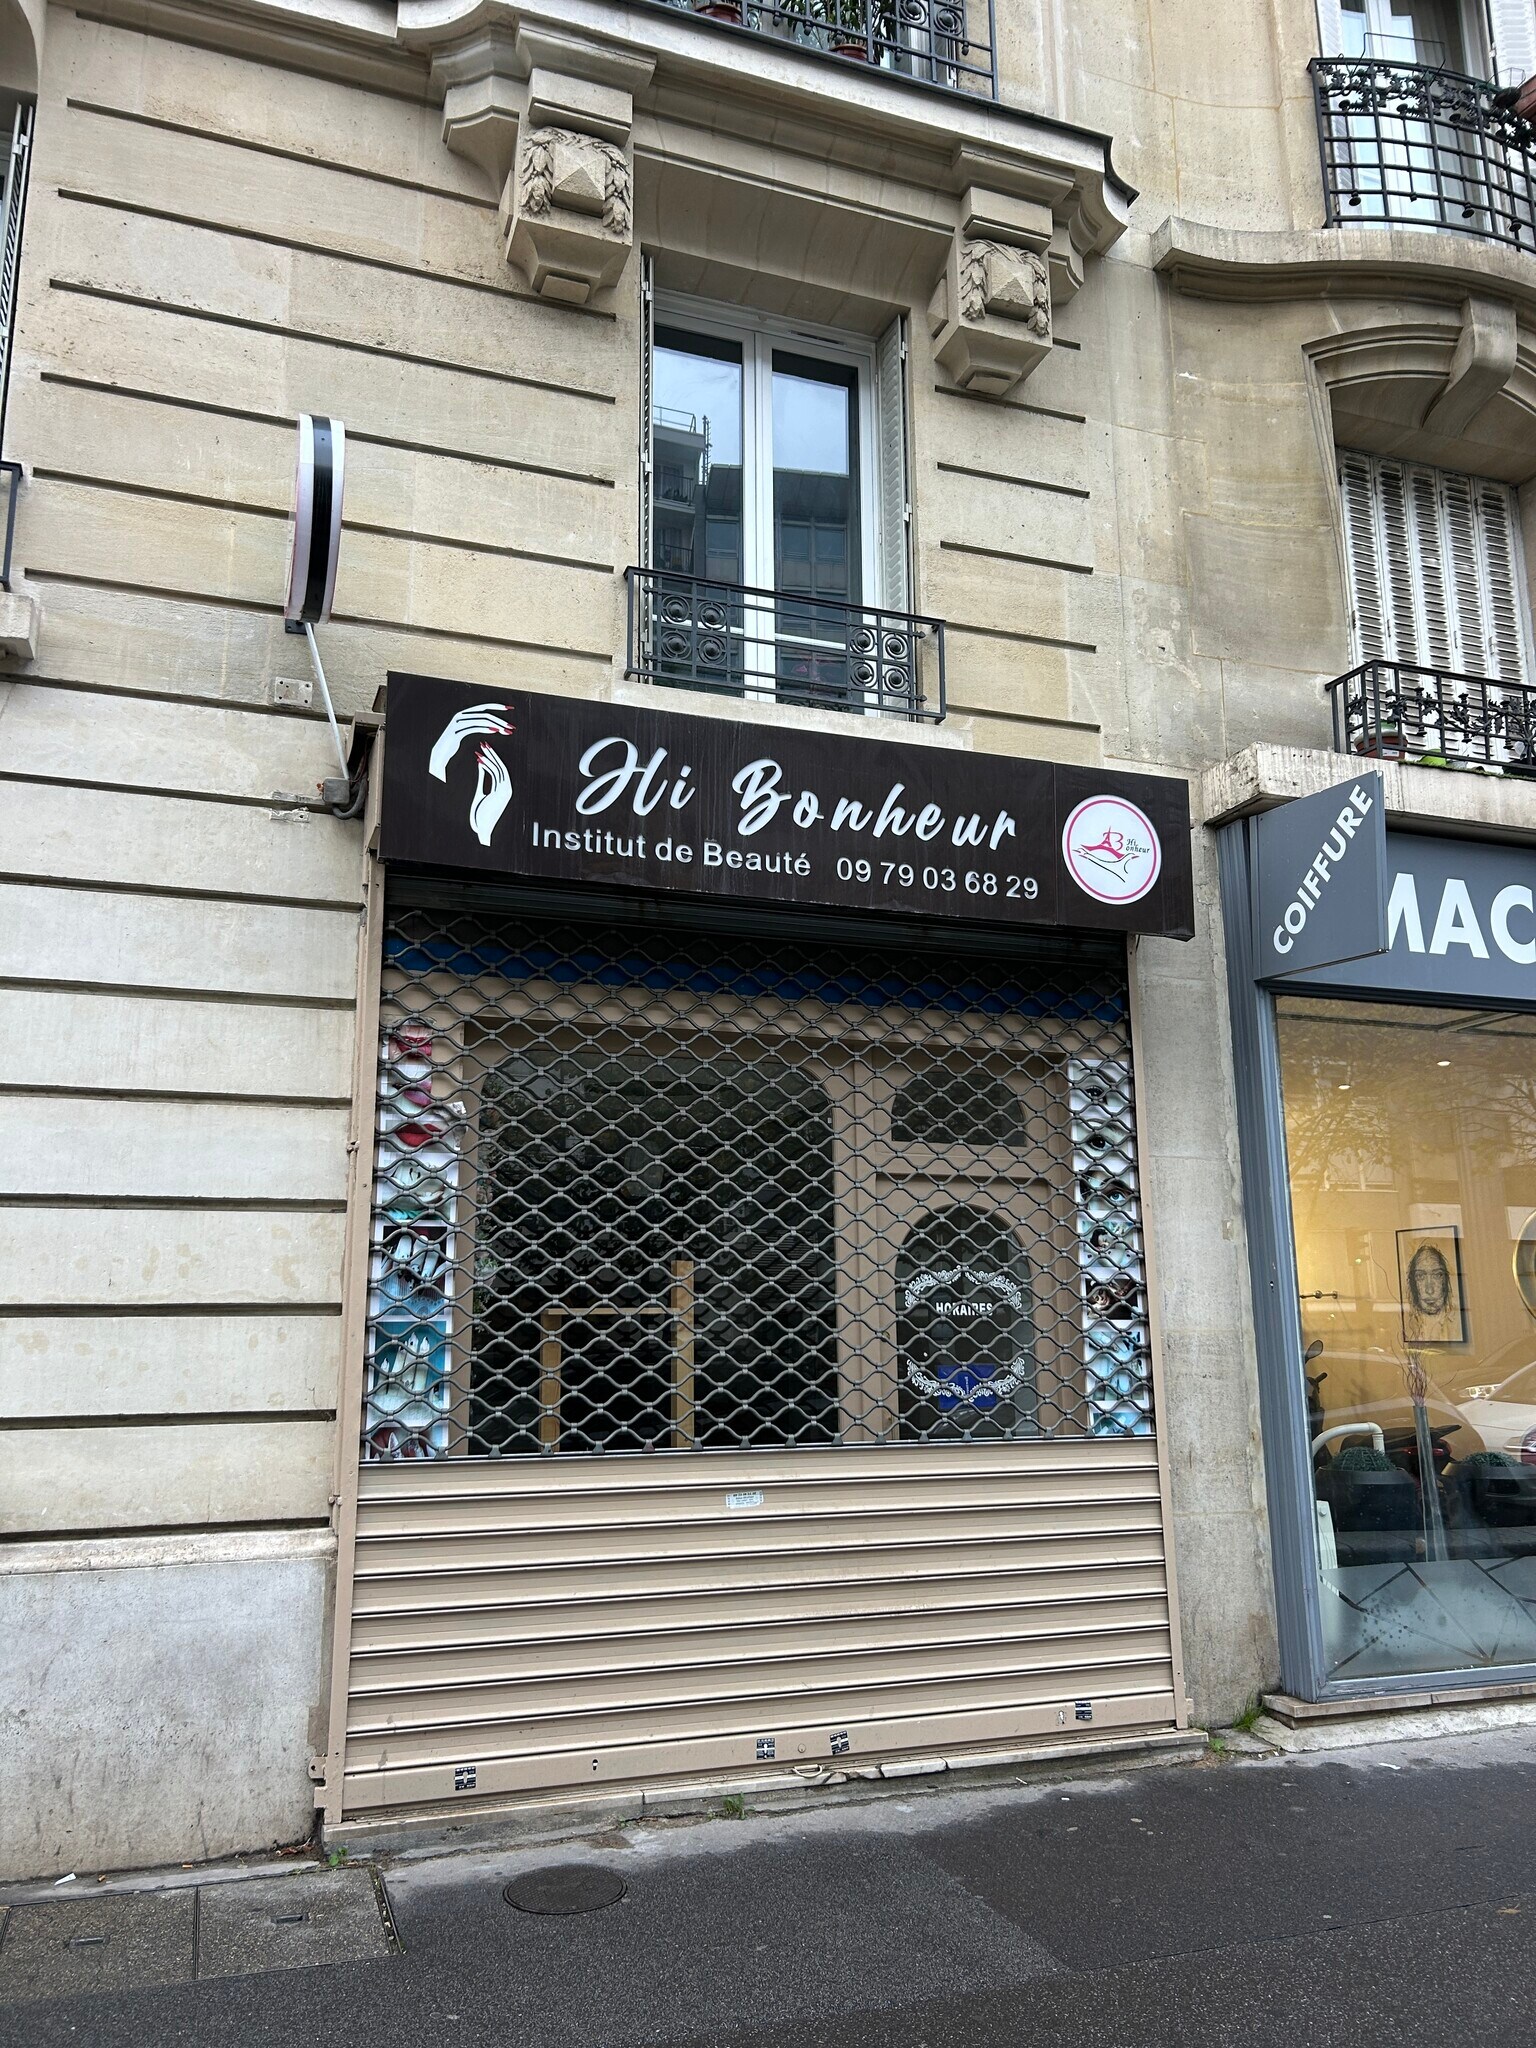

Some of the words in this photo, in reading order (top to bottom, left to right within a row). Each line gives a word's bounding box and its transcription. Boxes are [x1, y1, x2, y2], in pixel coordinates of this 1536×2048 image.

[575, 736, 696, 817] Hi
[731, 758, 1017, 851] Bonheur
[532, 821, 646, 859] Institut
[654, 837, 693, 863] de
[703, 841, 811, 876] Beauté
[836, 857, 872, 883] 09
[880, 861, 914, 887] 79
[922, 866, 957, 892] 03
[964, 871, 998, 896] 68
[1005, 875, 1038, 900] 29
[1273, 784, 1374, 954] COIFFURE
